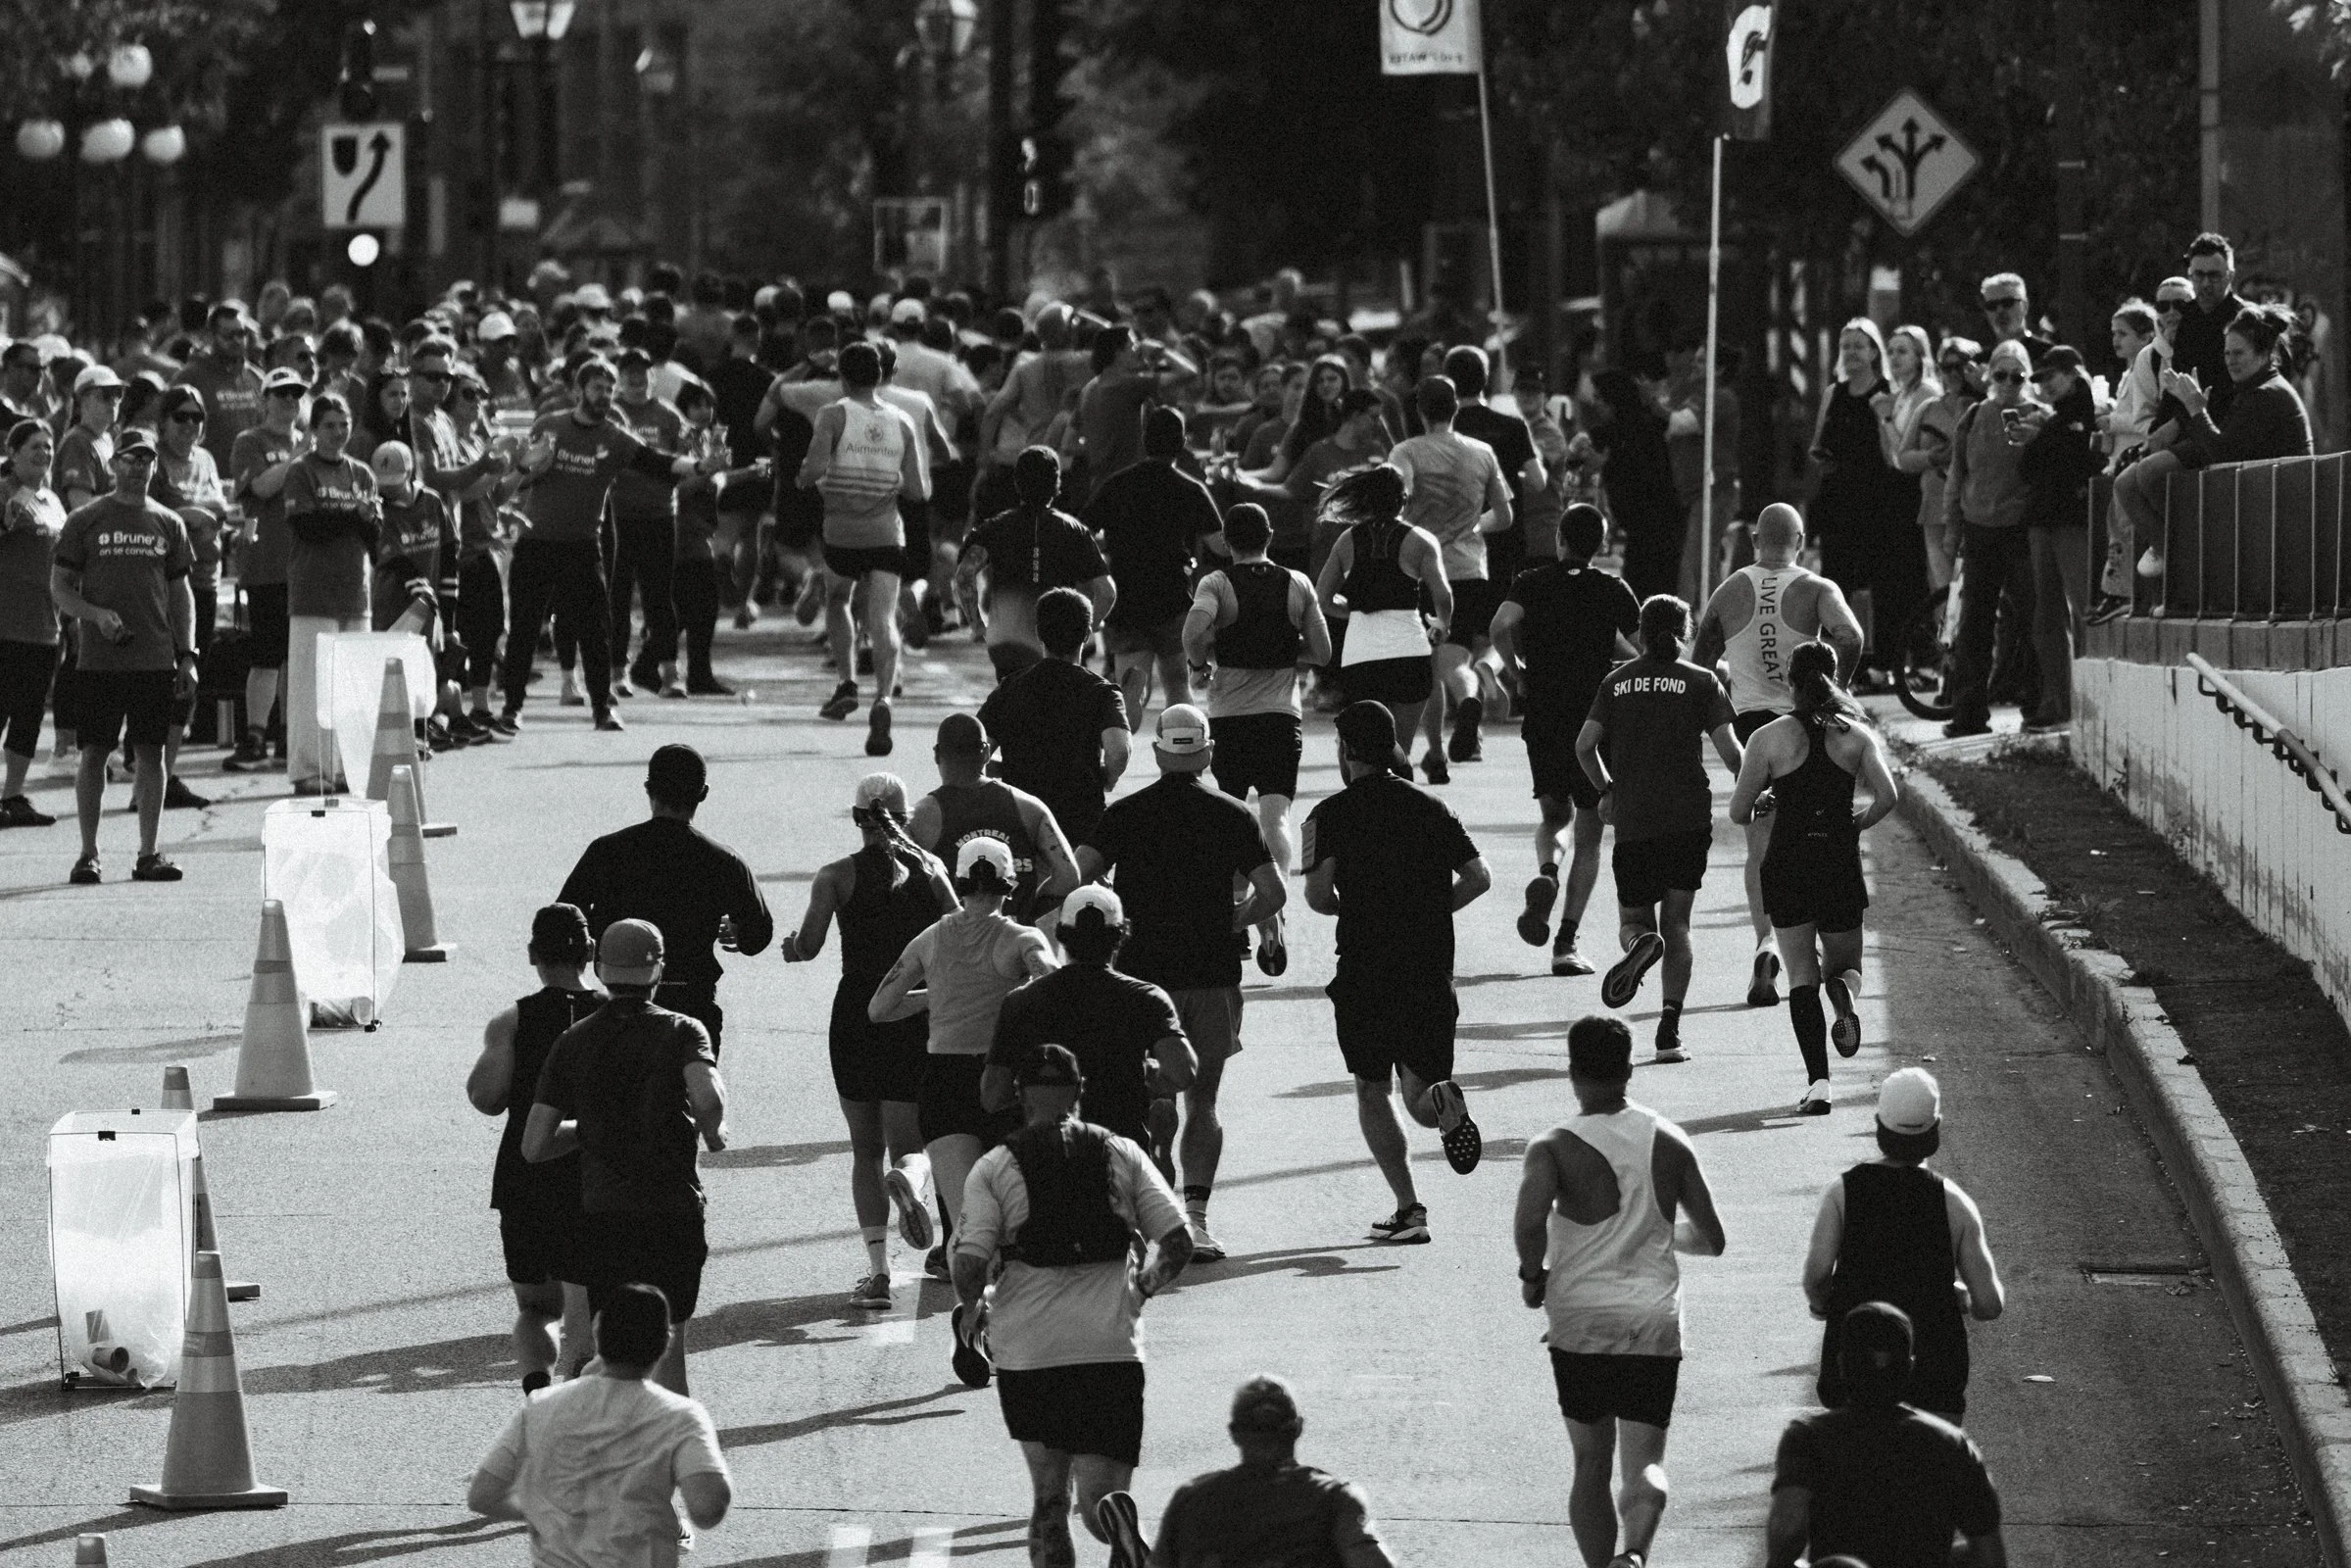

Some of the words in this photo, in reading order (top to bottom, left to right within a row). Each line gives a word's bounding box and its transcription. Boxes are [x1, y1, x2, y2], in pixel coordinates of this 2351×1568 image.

[1760, 577, 1778, 615] LIVE
[1759, 622, 1784, 682] GREAT
[1613, 678, 1632, 697] SKI
[1634, 676, 1651, 692] DE
[1653, 676, 1687, 695] FOND
[955, 829, 1010, 848] MONTREAL
